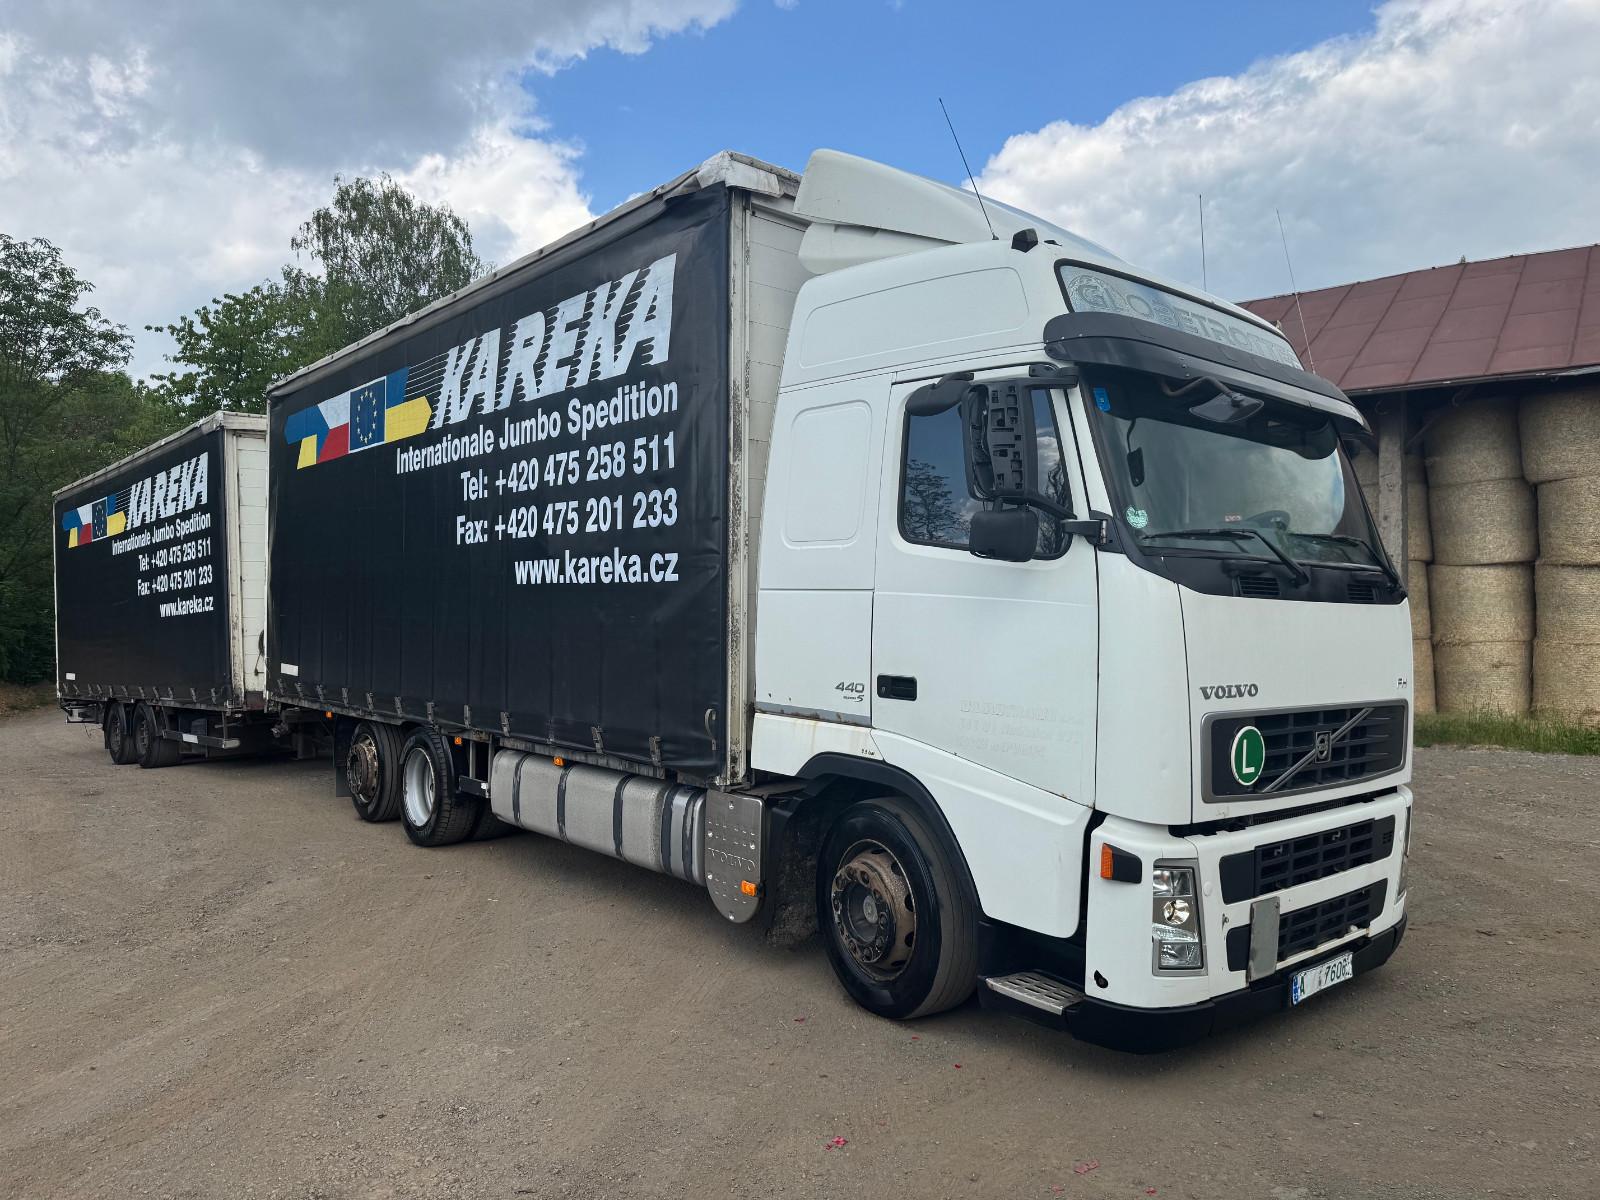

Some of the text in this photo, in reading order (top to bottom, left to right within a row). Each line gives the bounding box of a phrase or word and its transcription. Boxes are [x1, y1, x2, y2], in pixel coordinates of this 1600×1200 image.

[428, 252, 677, 429] KAREKA
[396, 380, 678, 474] Internationale Jumbo Spedition
[461, 431, 675, 501] Tel: +420 475 258 511
[126, 452, 208, 531] KAREKA
[112, 512, 211, 556] Internationale Jumbo Spedition
[456, 487, 678, 545] Fax: +420 475 201 233
[138, 536, 211, 572] Tel: +420 475 258 511
[514, 546, 679, 585] www.kareka.cz
[137, 564, 213, 597] Fax: +420 475 201 233
[159, 594, 214, 618] www.kareka.cz
[835, 681, 865, 693] 440
[1200, 683, 1259, 700] VOLVO
[1242, 738, 1256, 774] L
